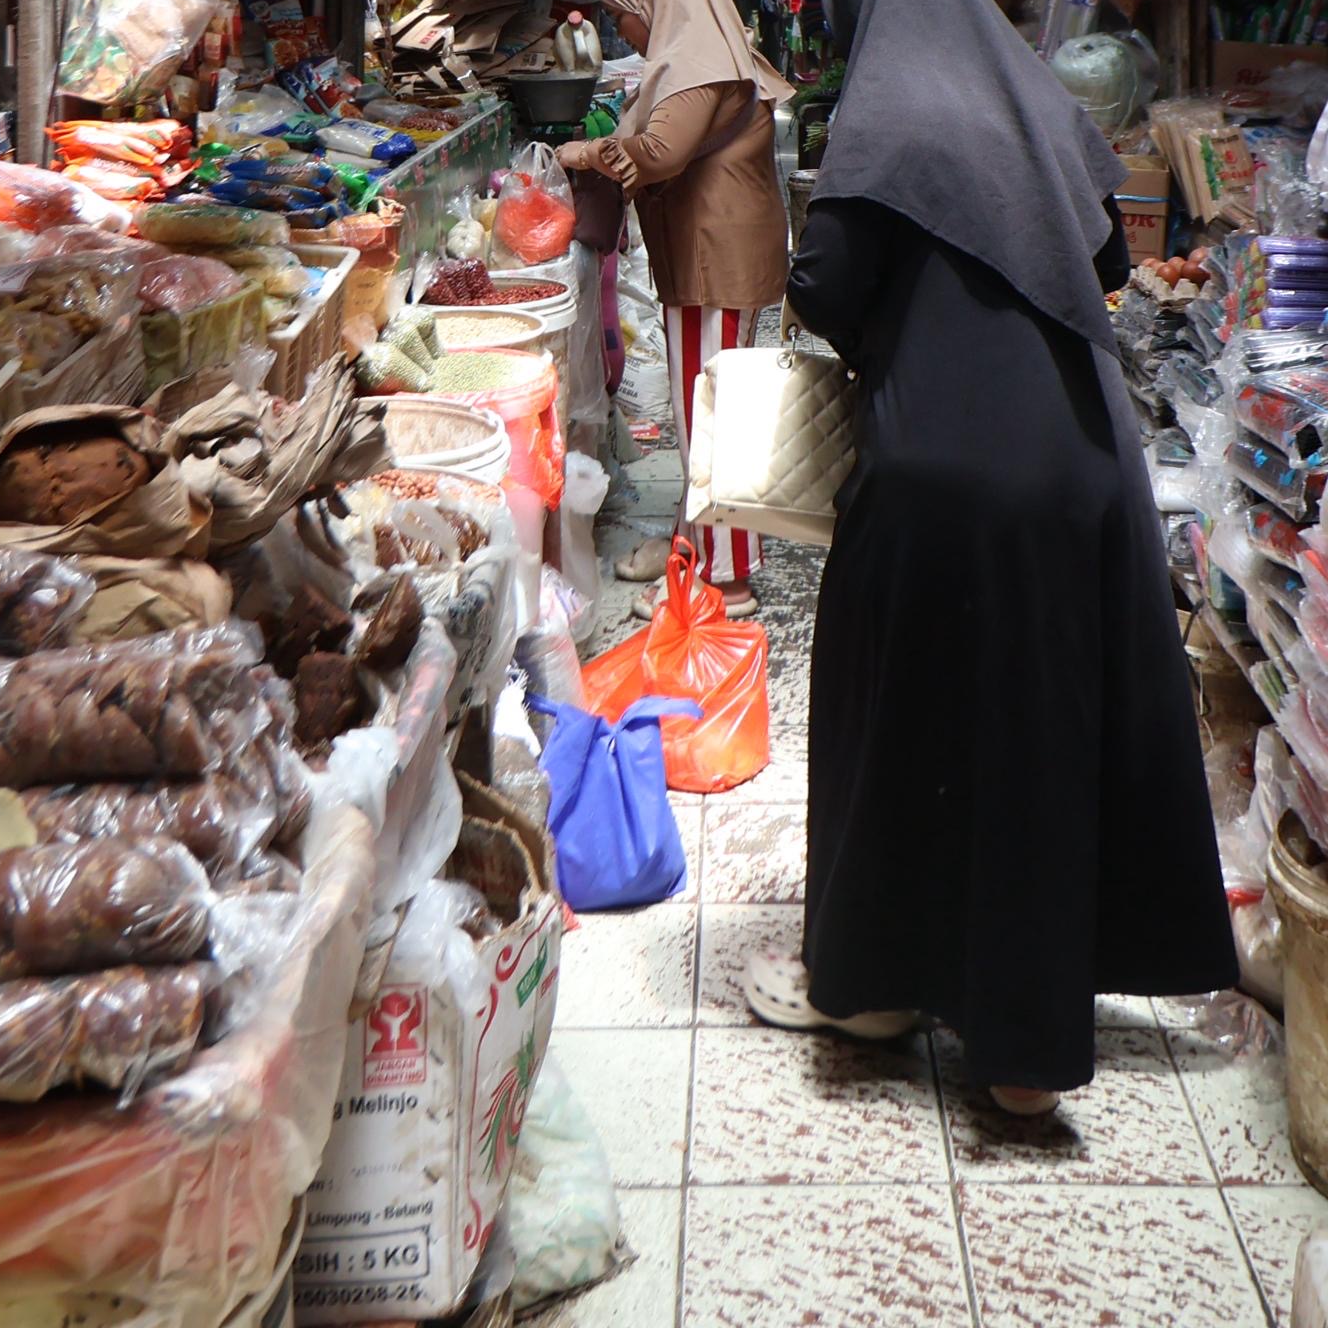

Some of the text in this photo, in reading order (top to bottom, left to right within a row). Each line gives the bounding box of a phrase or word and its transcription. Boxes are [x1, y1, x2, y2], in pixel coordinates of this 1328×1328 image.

[350, 1092, 419, 1117] Melinjo
[362, 1250, 376, 1271] 5
[383, 1246, 421, 1270] KG
